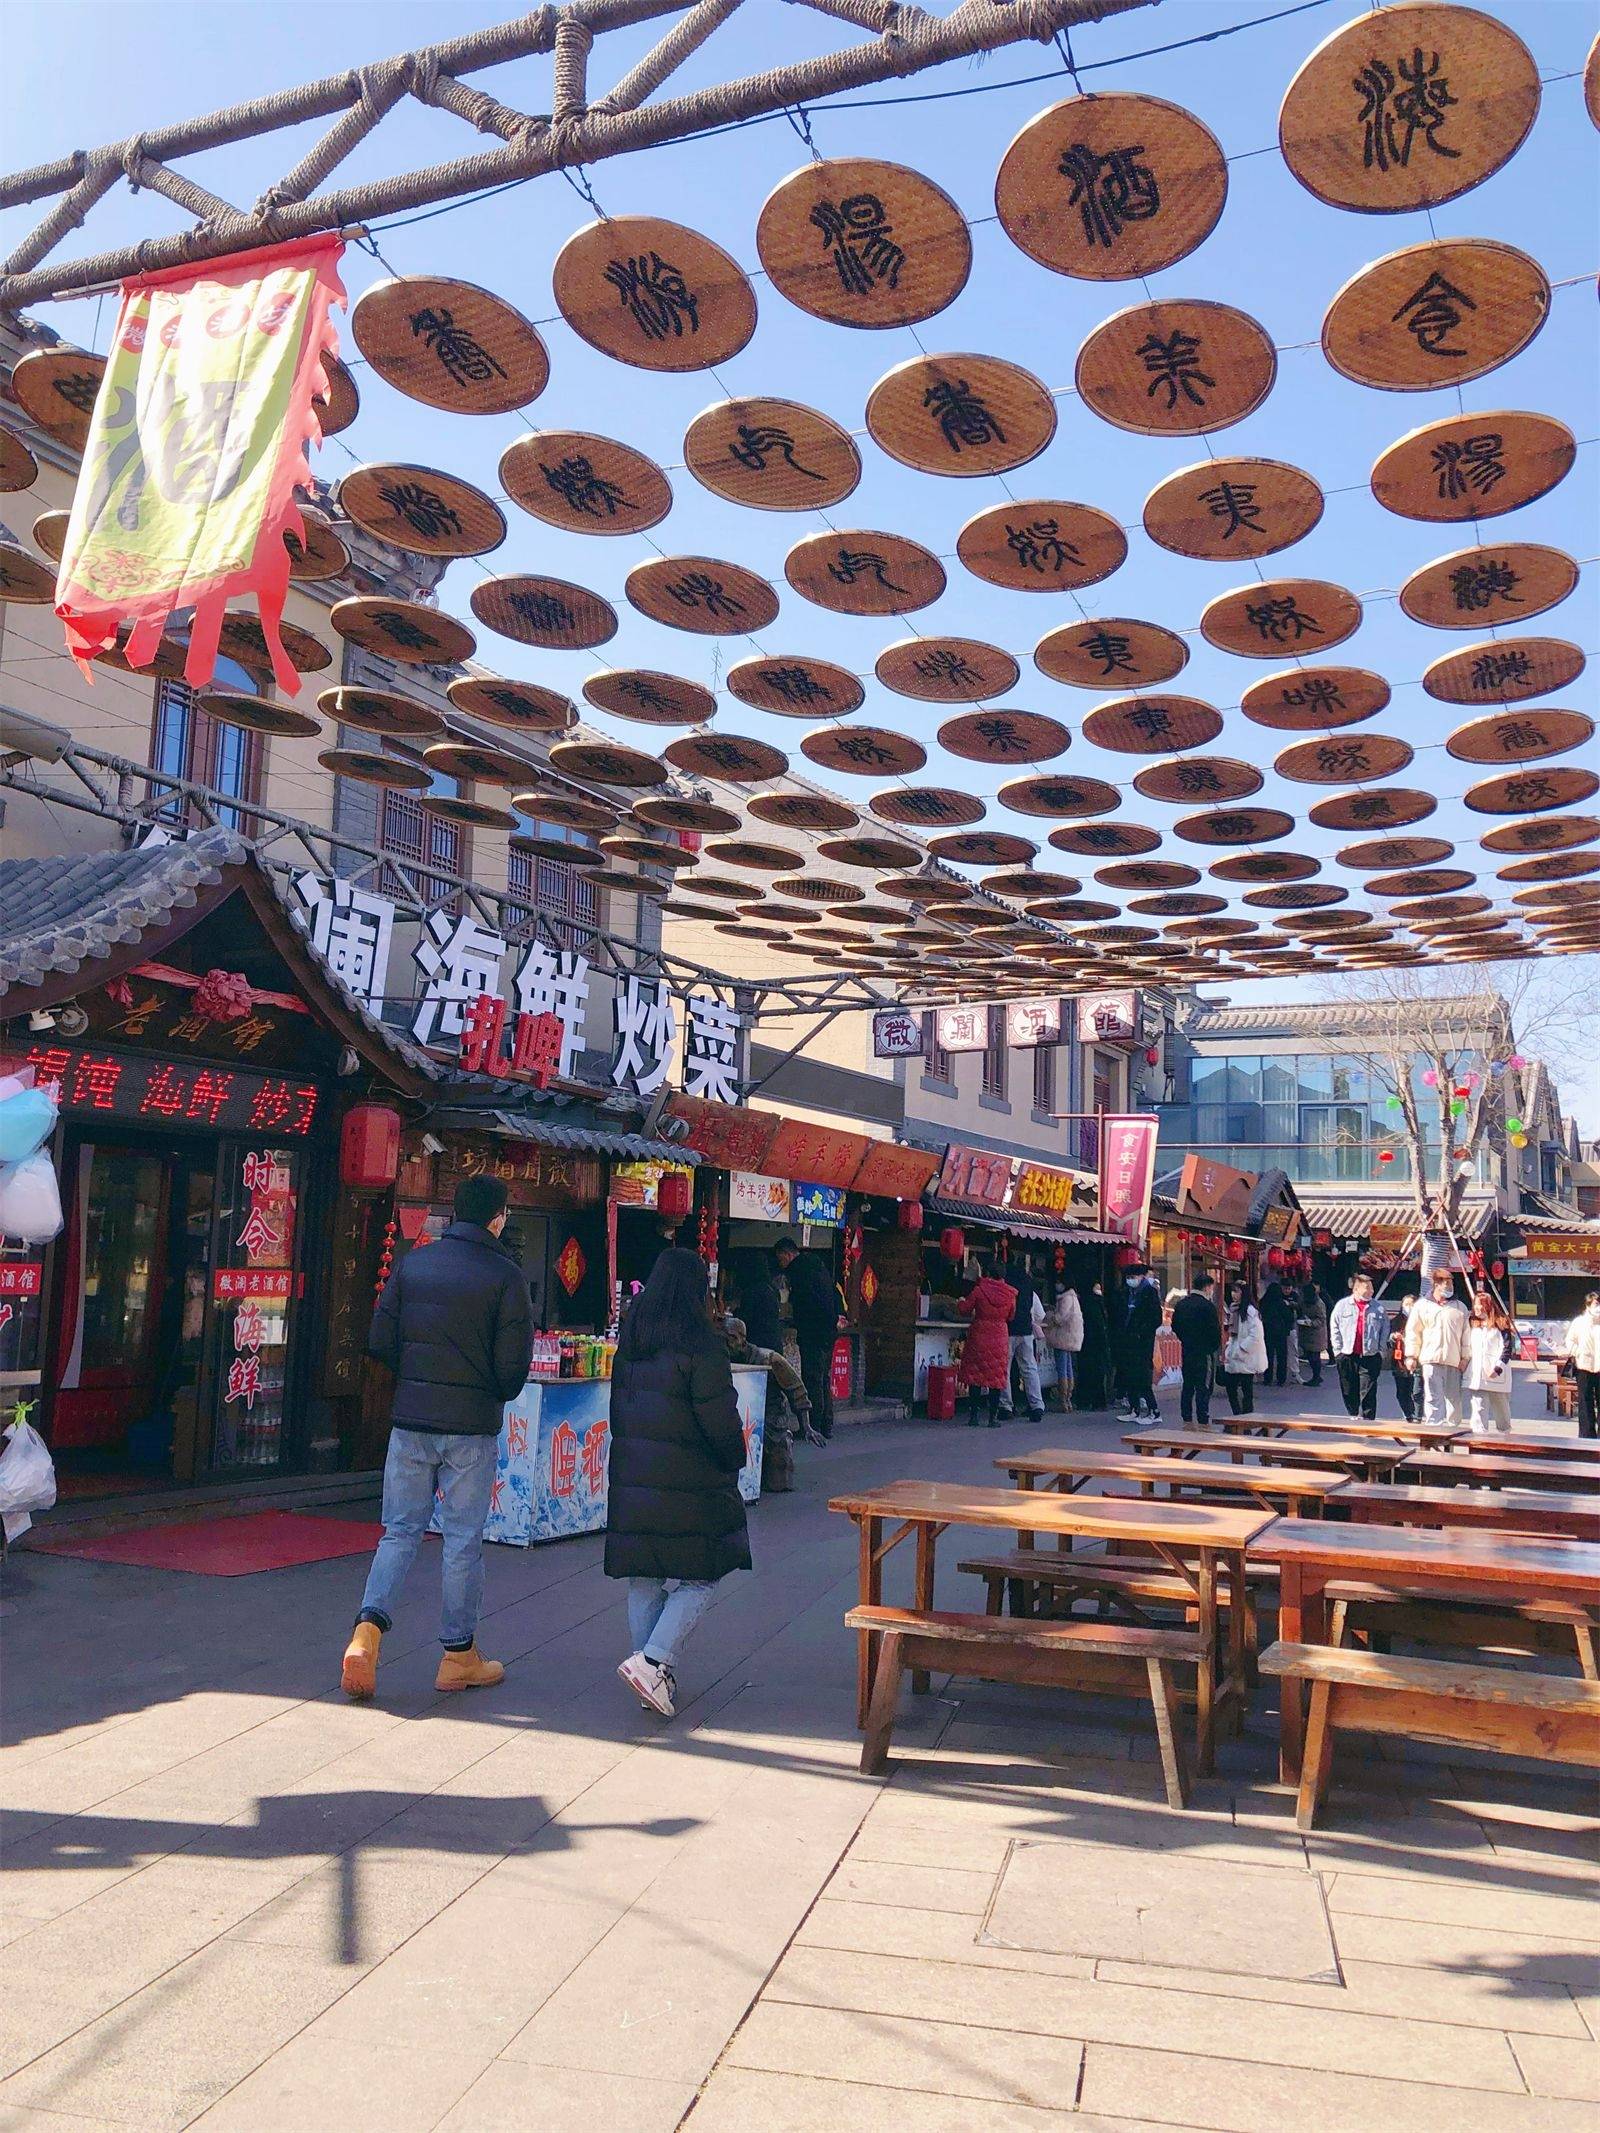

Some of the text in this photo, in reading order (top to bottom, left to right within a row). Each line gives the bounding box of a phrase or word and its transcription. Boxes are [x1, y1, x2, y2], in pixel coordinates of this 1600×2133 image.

[460, 993, 565, 1090] 扎啤
[886, 1019, 912, 1047] 微
[1021, 1008, 1047, 1036] 酒
[224, 1149, 279, 1410] 时令 海鲜
